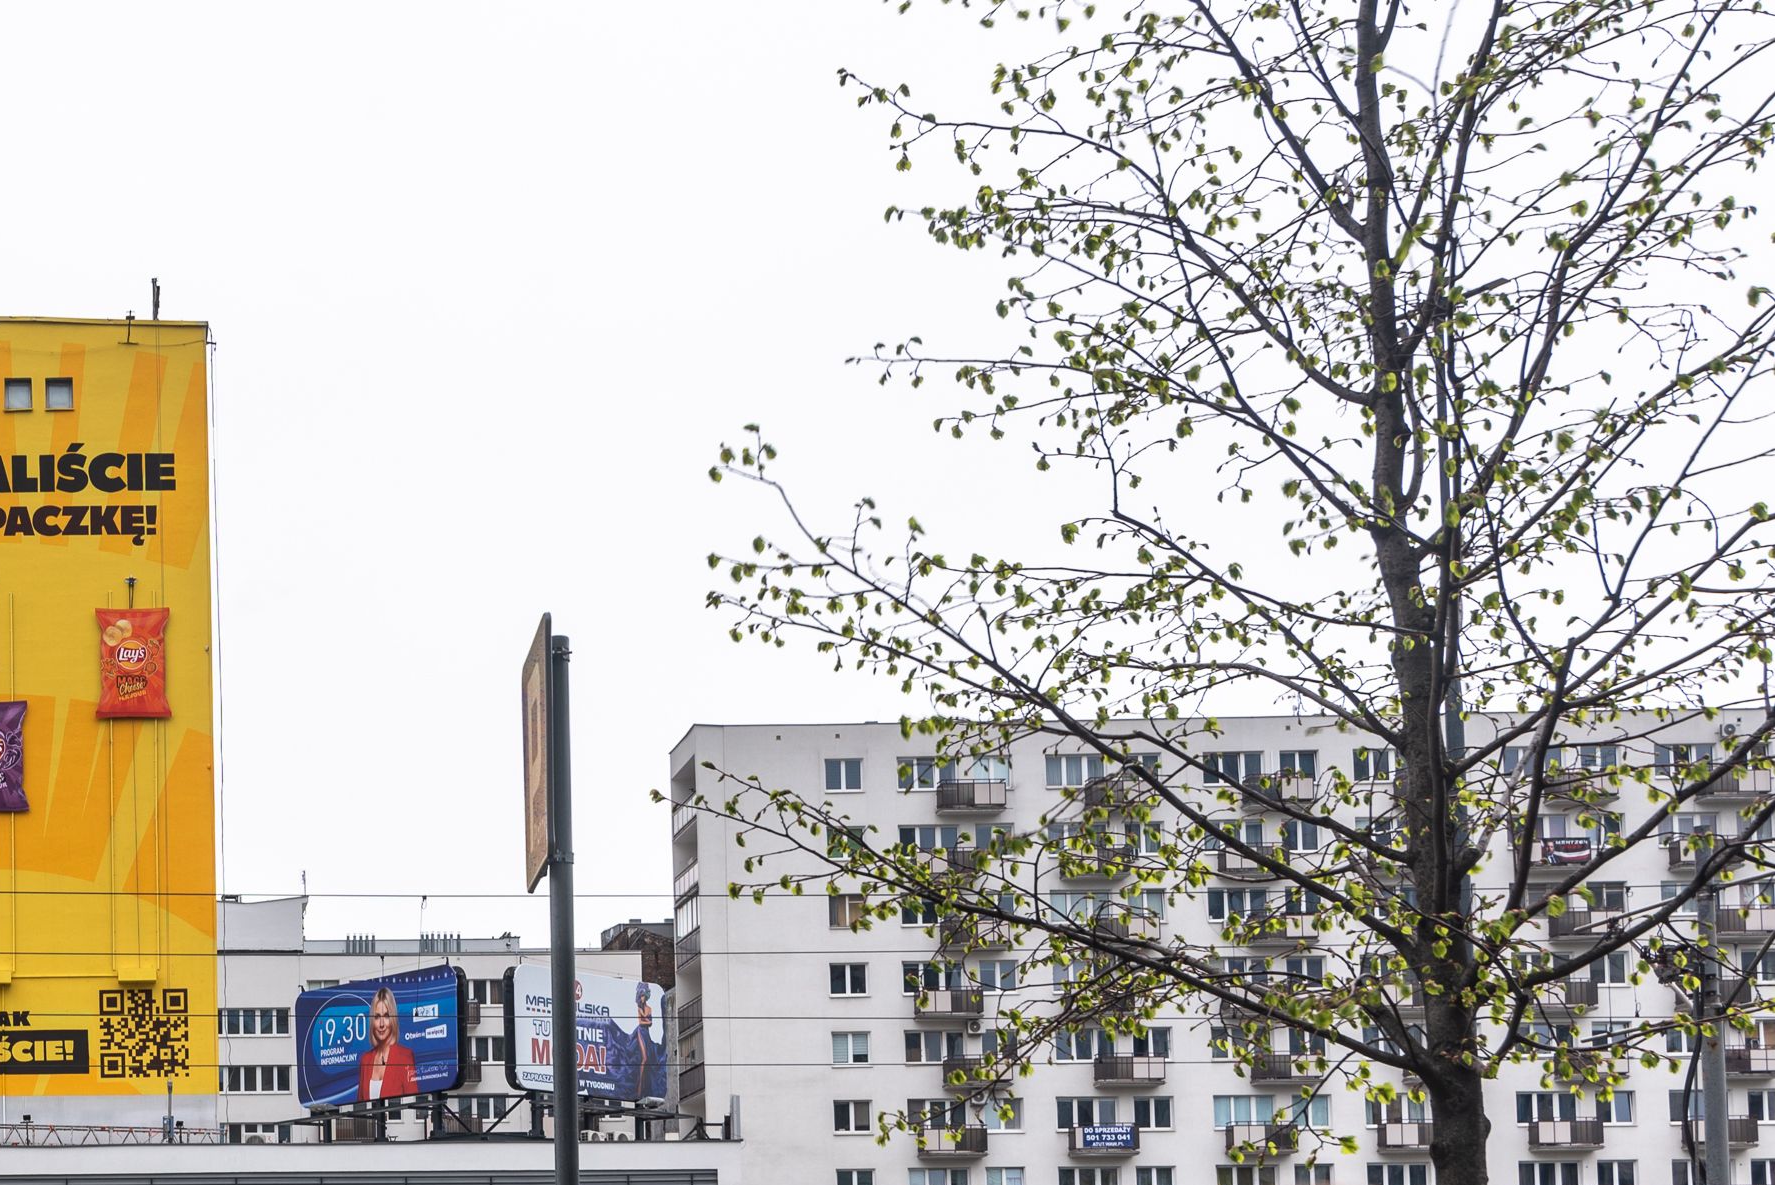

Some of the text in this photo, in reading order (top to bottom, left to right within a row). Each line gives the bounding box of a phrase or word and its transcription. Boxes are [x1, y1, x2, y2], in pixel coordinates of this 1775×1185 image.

[119, 646, 145, 663] Lay's
[533, 1019, 551, 1036] TU
[320, 1047, 345, 1057] PROGRAM
[320, 1053, 358, 1066] INFORMACYJNY
[586, 1079, 615, 1091] TYGODNIU
